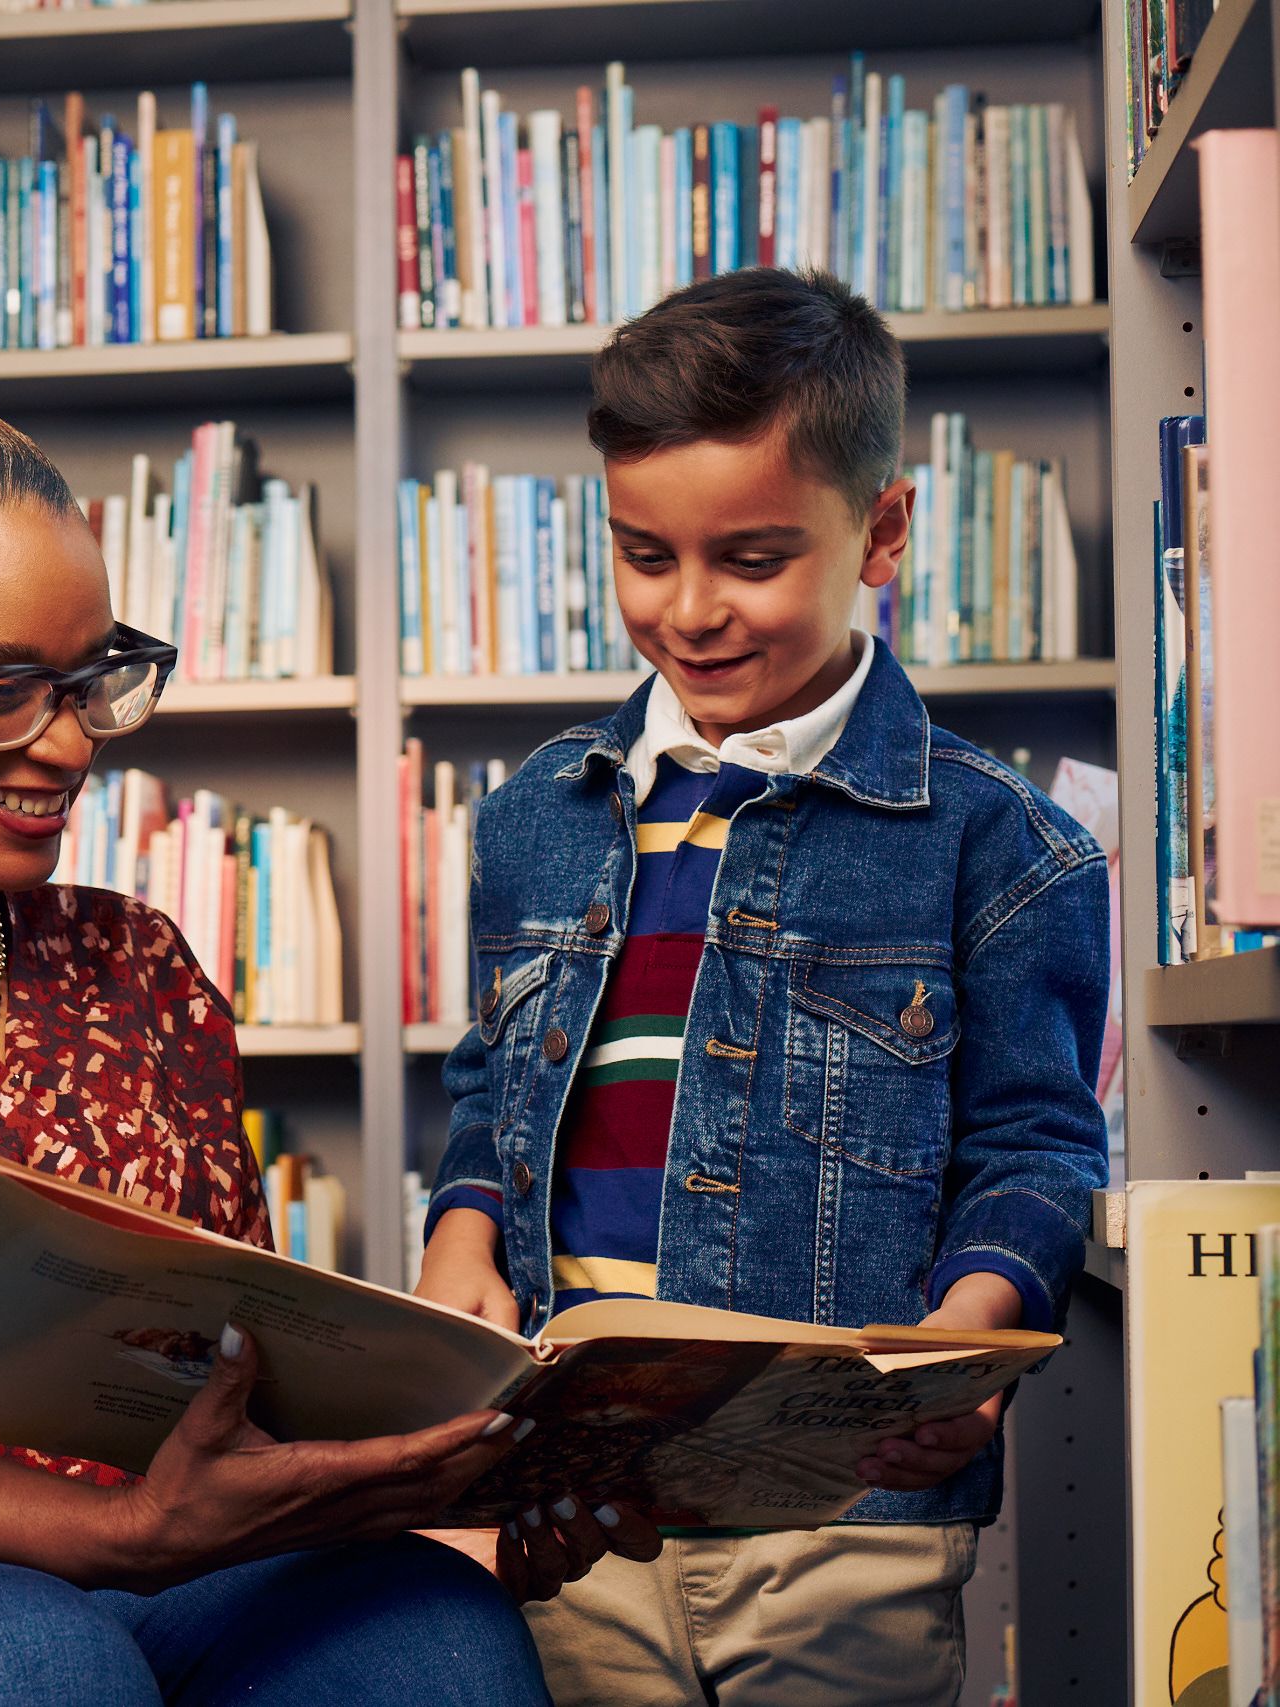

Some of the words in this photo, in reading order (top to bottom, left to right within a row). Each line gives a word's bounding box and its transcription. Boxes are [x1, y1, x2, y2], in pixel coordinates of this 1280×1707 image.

[845, 1373, 897, 1391] of
[886, 1379, 913, 1391] a
[779, 1391, 923, 1411] Church
[764, 1410, 897, 1429] Mouse
[752, 1489, 841, 1502] Graham
